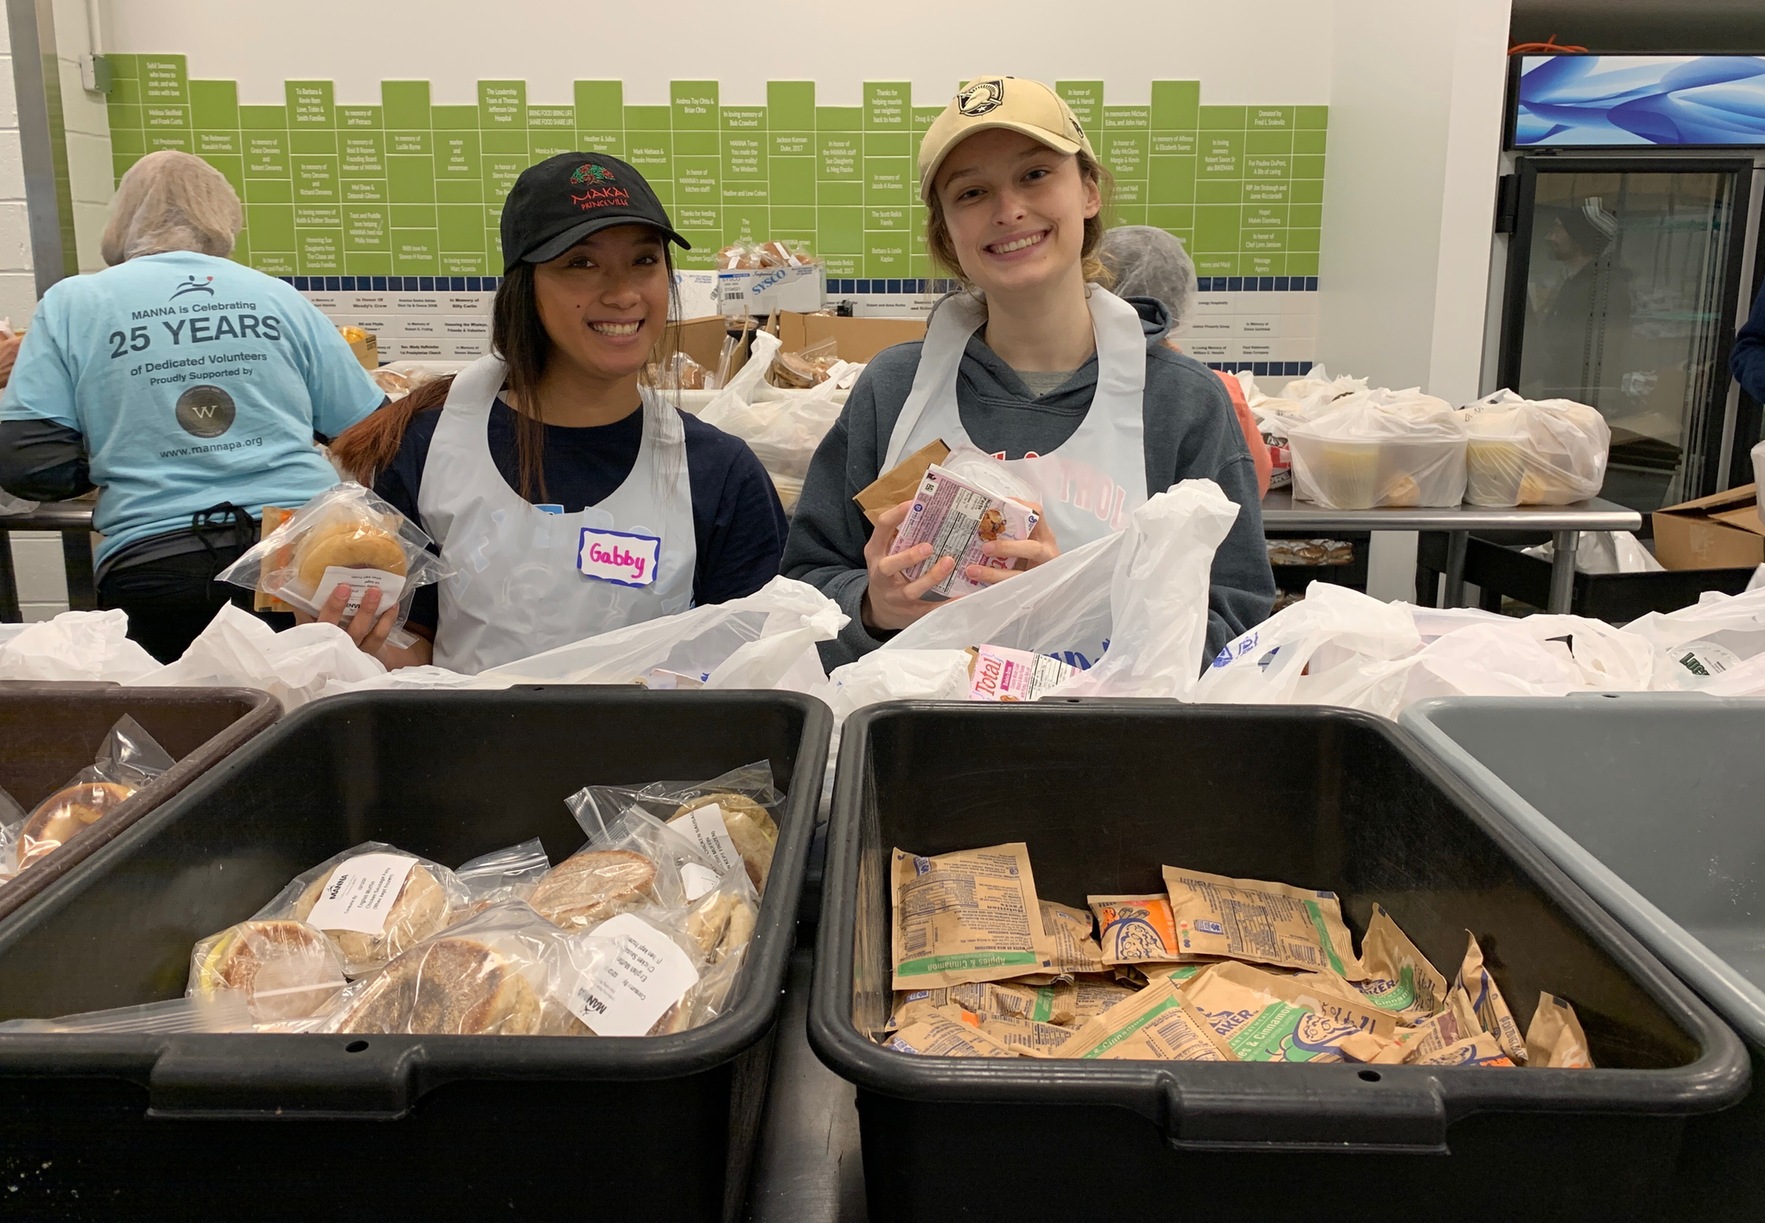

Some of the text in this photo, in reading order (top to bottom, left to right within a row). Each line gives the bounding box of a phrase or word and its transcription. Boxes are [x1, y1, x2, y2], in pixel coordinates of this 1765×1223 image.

[571, 187, 629, 205] MAKAI
[752, 270, 785, 295] SYSCO
[132, 301, 256, 320] MANNA is Celebrating
[109, 315, 281, 359] 25 YEARS
[130, 352, 267, 377] of Dedicated Volunteers
[150, 367, 253, 386] Proudly Supported by
[192, 405, 217, 418] W
[160, 437, 263, 458] www.mannapa.org
[590, 543, 645, 579] Gabby
[975, 658, 1001, 695] Total
[329, 874, 348, 900] MANNA
[1215, 1009, 1253, 1035] AKER
